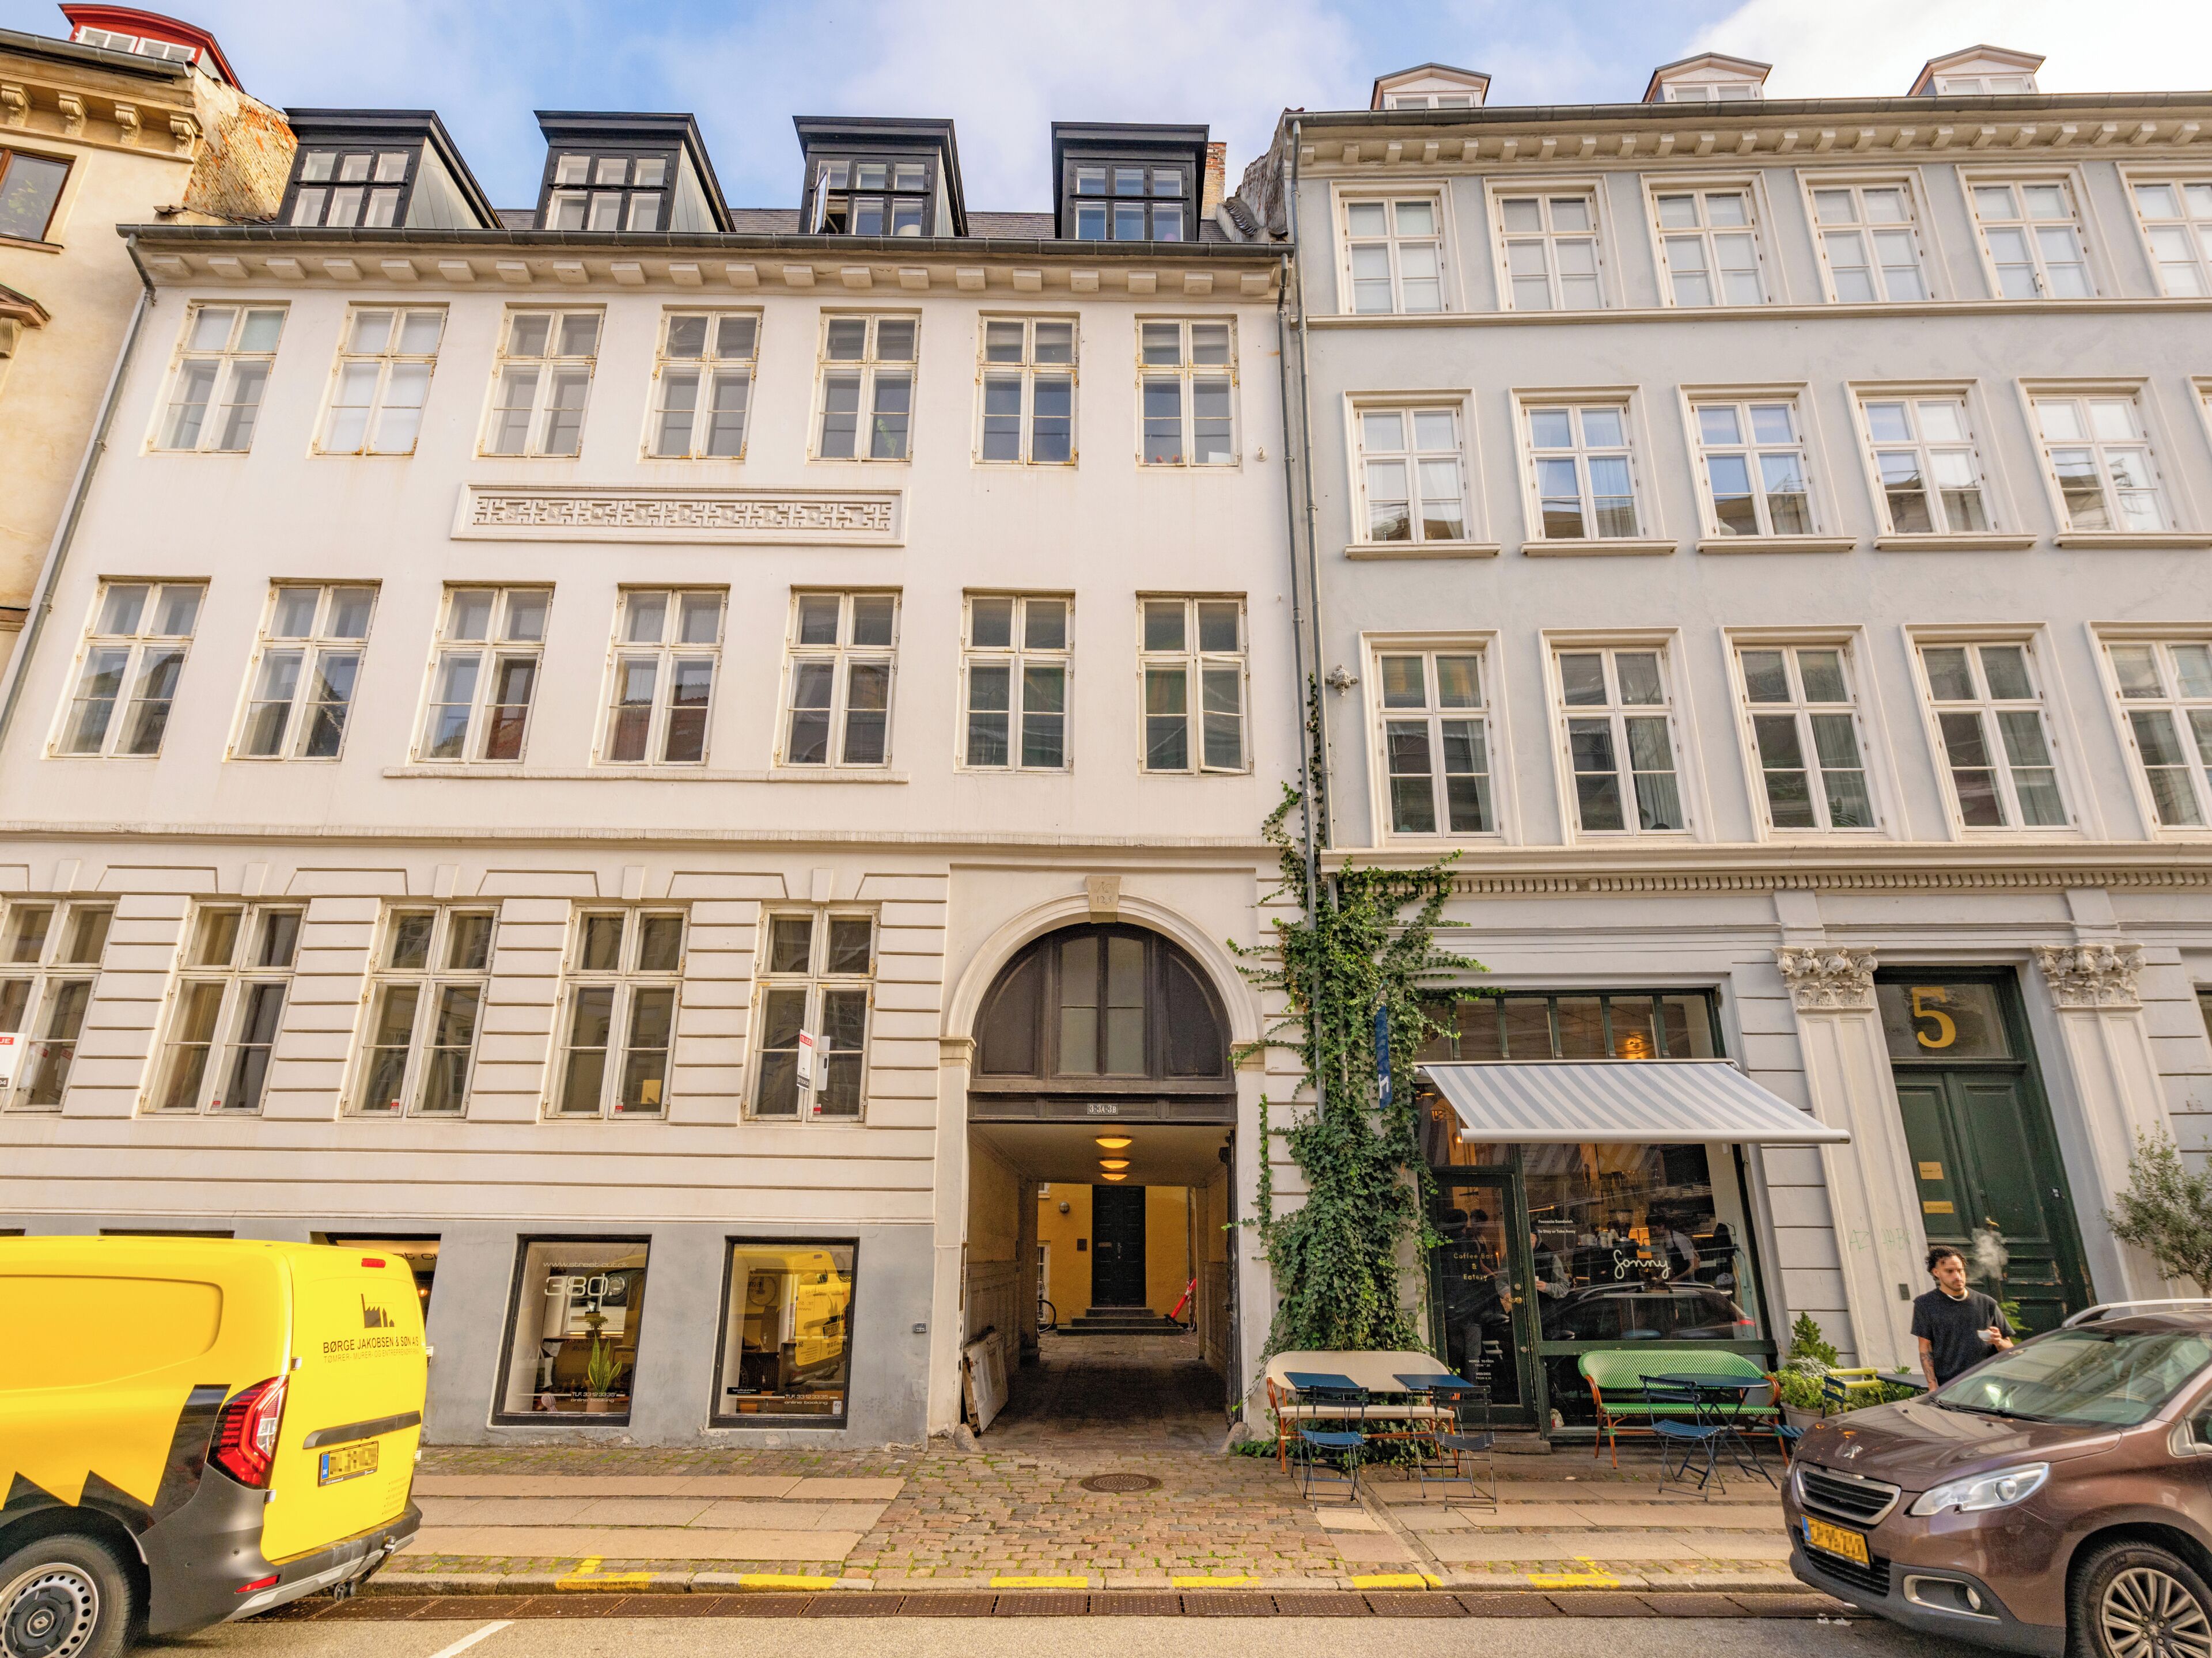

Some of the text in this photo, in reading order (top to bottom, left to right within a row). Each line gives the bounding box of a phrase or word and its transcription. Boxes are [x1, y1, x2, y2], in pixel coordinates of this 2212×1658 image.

[1911, 986, 1956, 1048] 5
[1613, 1249, 1671, 1279] Sonny
[323, 1339, 355, 1353] BØRGE
[357, 1337, 394, 1350] JAKOBSEN
